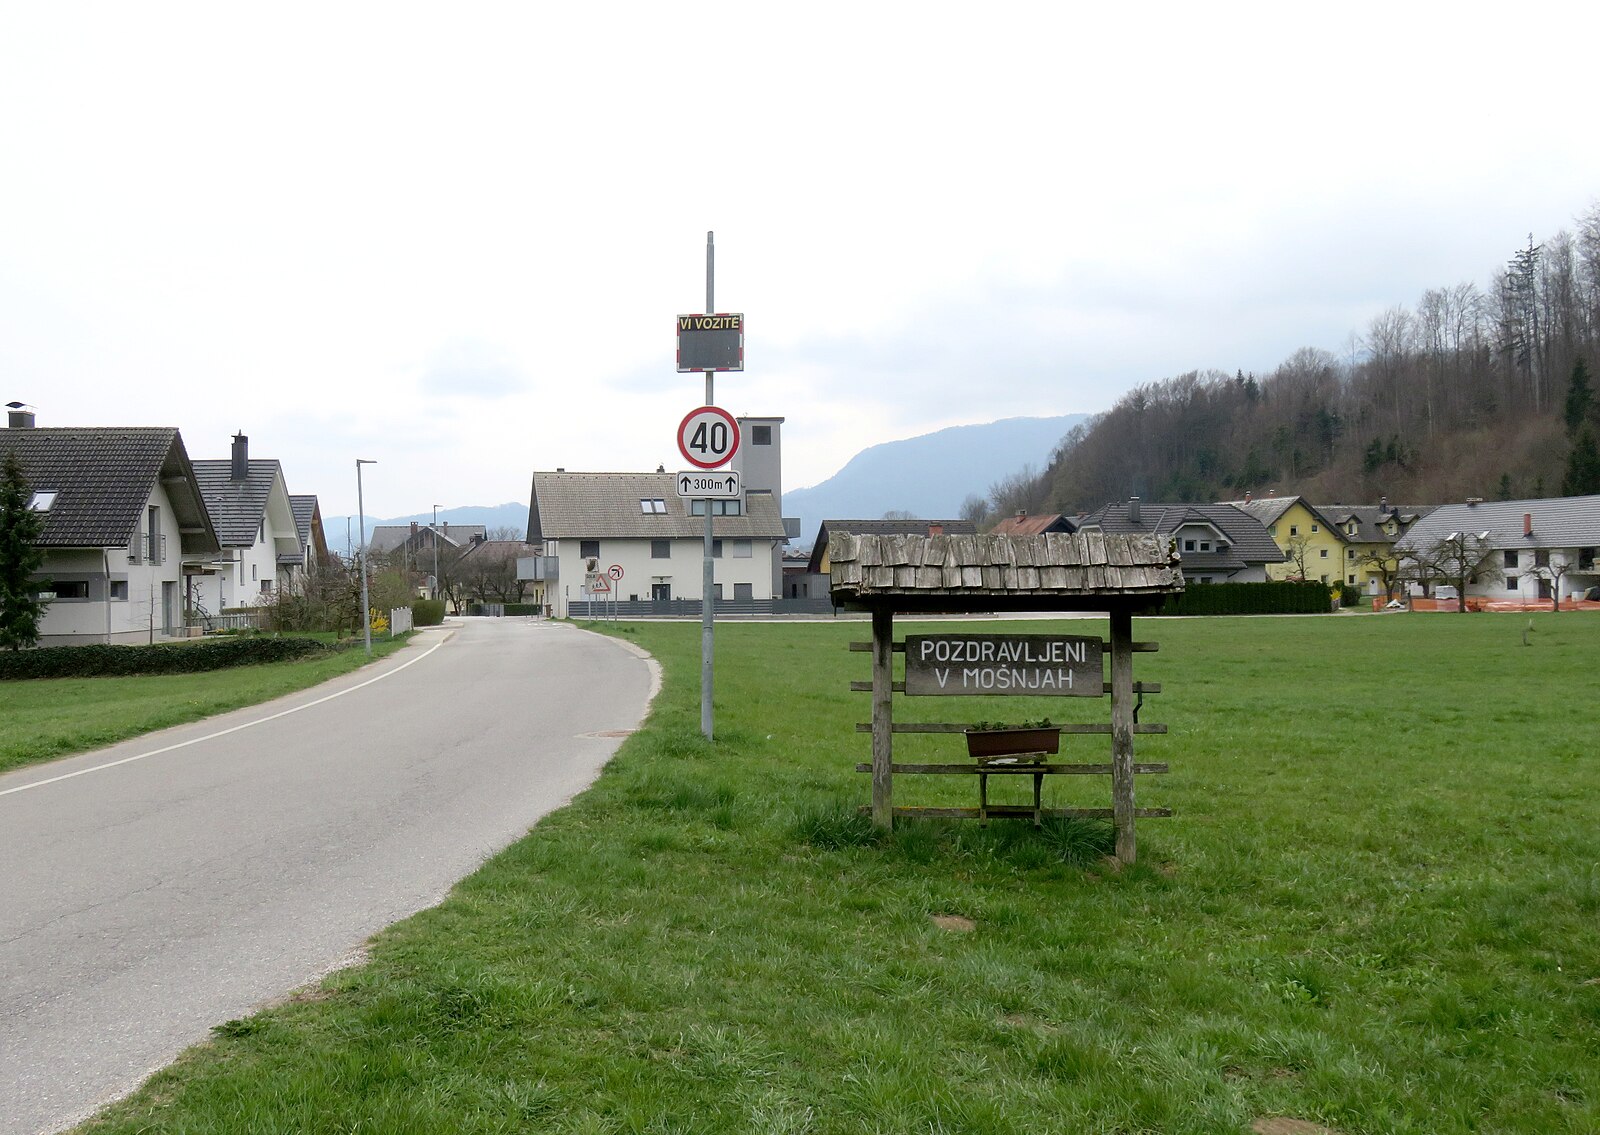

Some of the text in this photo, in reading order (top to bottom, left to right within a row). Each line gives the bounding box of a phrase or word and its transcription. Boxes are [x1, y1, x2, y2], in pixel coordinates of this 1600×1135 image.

[680, 317, 739, 330] VI VOZITE
[690, 422, 727, 454] 40
[694, 479, 723, 490] 300m
[921, 640, 1086, 662] POZDRAVLJENI
[935, 664, 1073, 689] V MOŠNJAH
